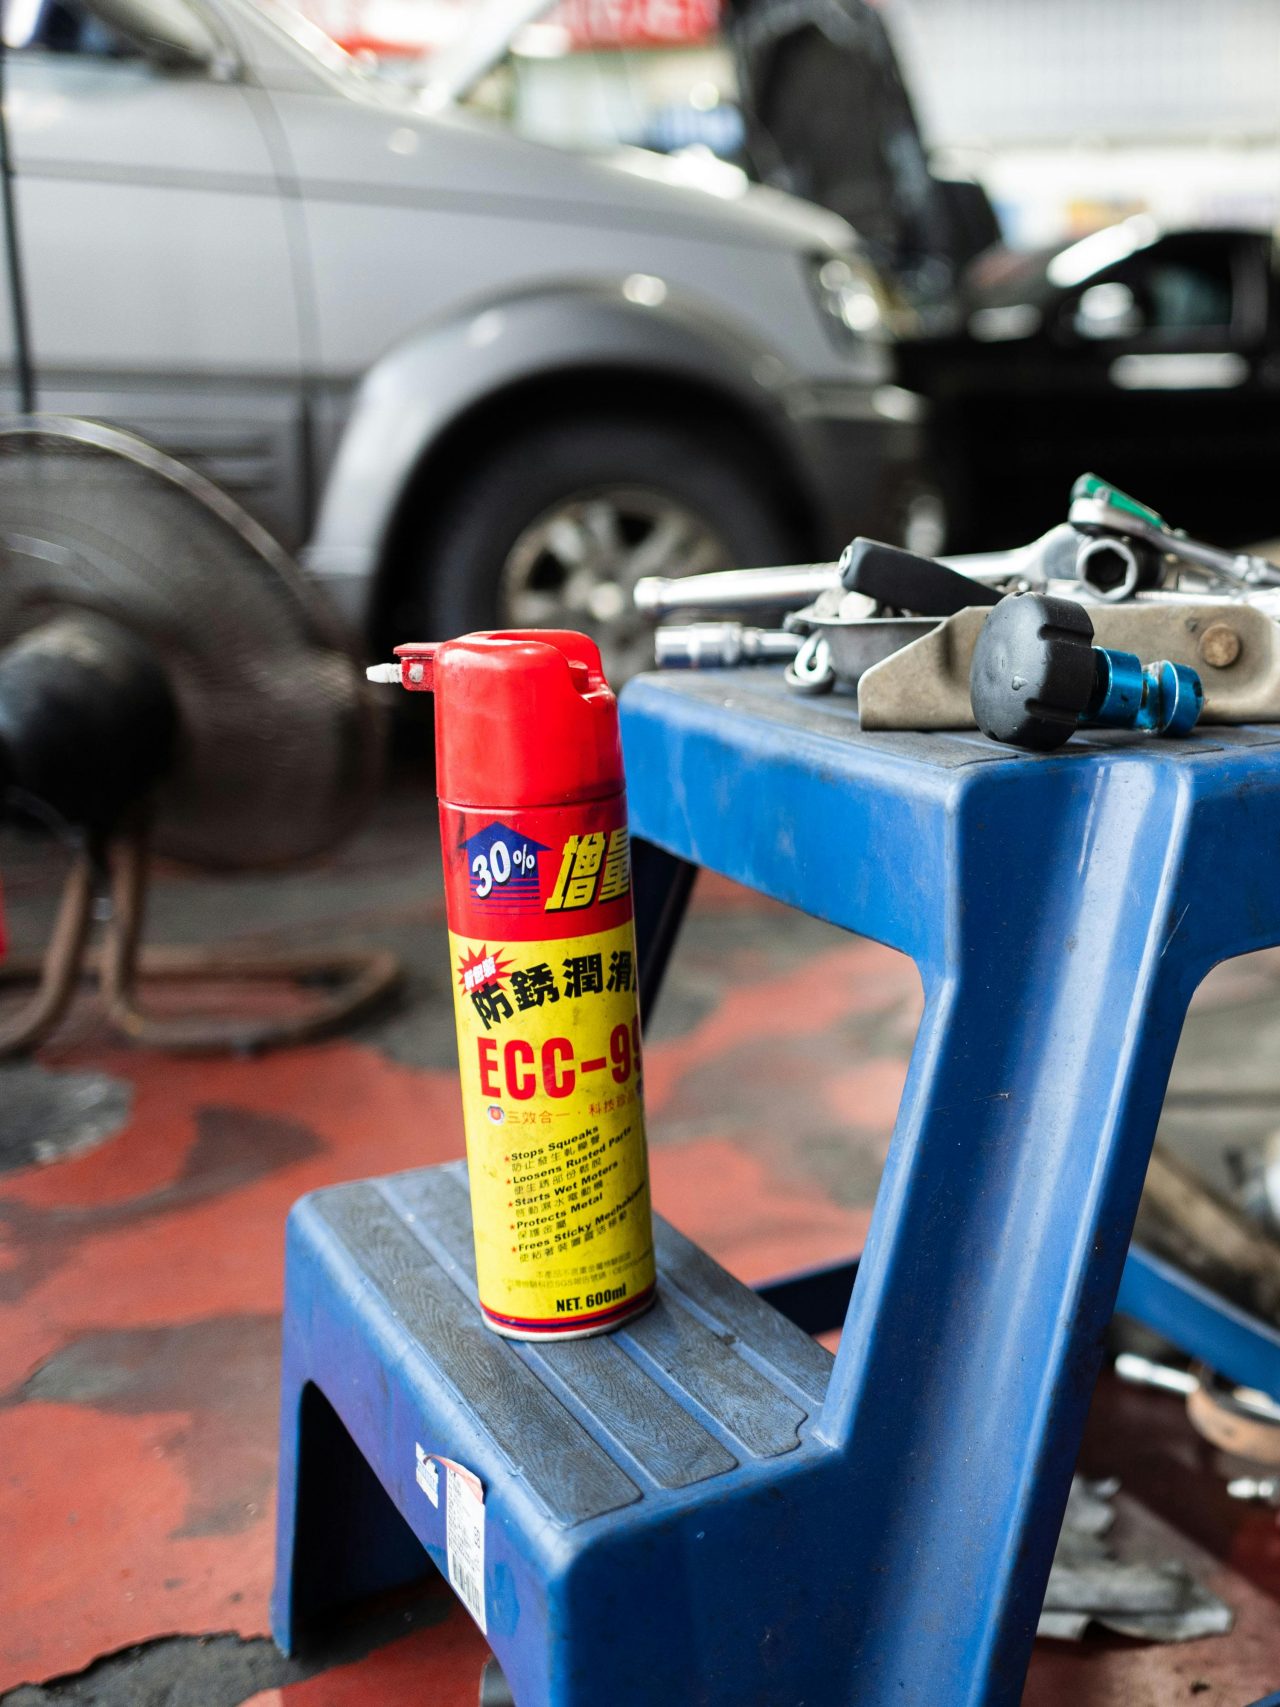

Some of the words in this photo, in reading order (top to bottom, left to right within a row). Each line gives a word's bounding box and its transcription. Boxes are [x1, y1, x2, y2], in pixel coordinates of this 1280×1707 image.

[472, 840, 535, 898] 30%
[544, 826, 630, 912] 增量
[471, 950, 638, 1030] 防銹潤滑
[511, 1148, 544, 1161] Stops
[548, 1126, 599, 1151] Squeaks
[513, 1166, 562, 1184] Loosens
[566, 1143, 606, 1168] Rusted
[608, 1126, 632, 1148] Parts
[515, 1193, 550, 1207] Starts
[554, 1182, 578, 1196] Wet
[517, 1210, 567, 1229] Protects
[570, 1191, 603, 1213] Metal
[518, 1239, 550, 1252] Frees
[554, 1222, 592, 1242] Sticky
[556, 1297, 583, 1312] NET.
[585, 1283, 627, 1308] 600ml
